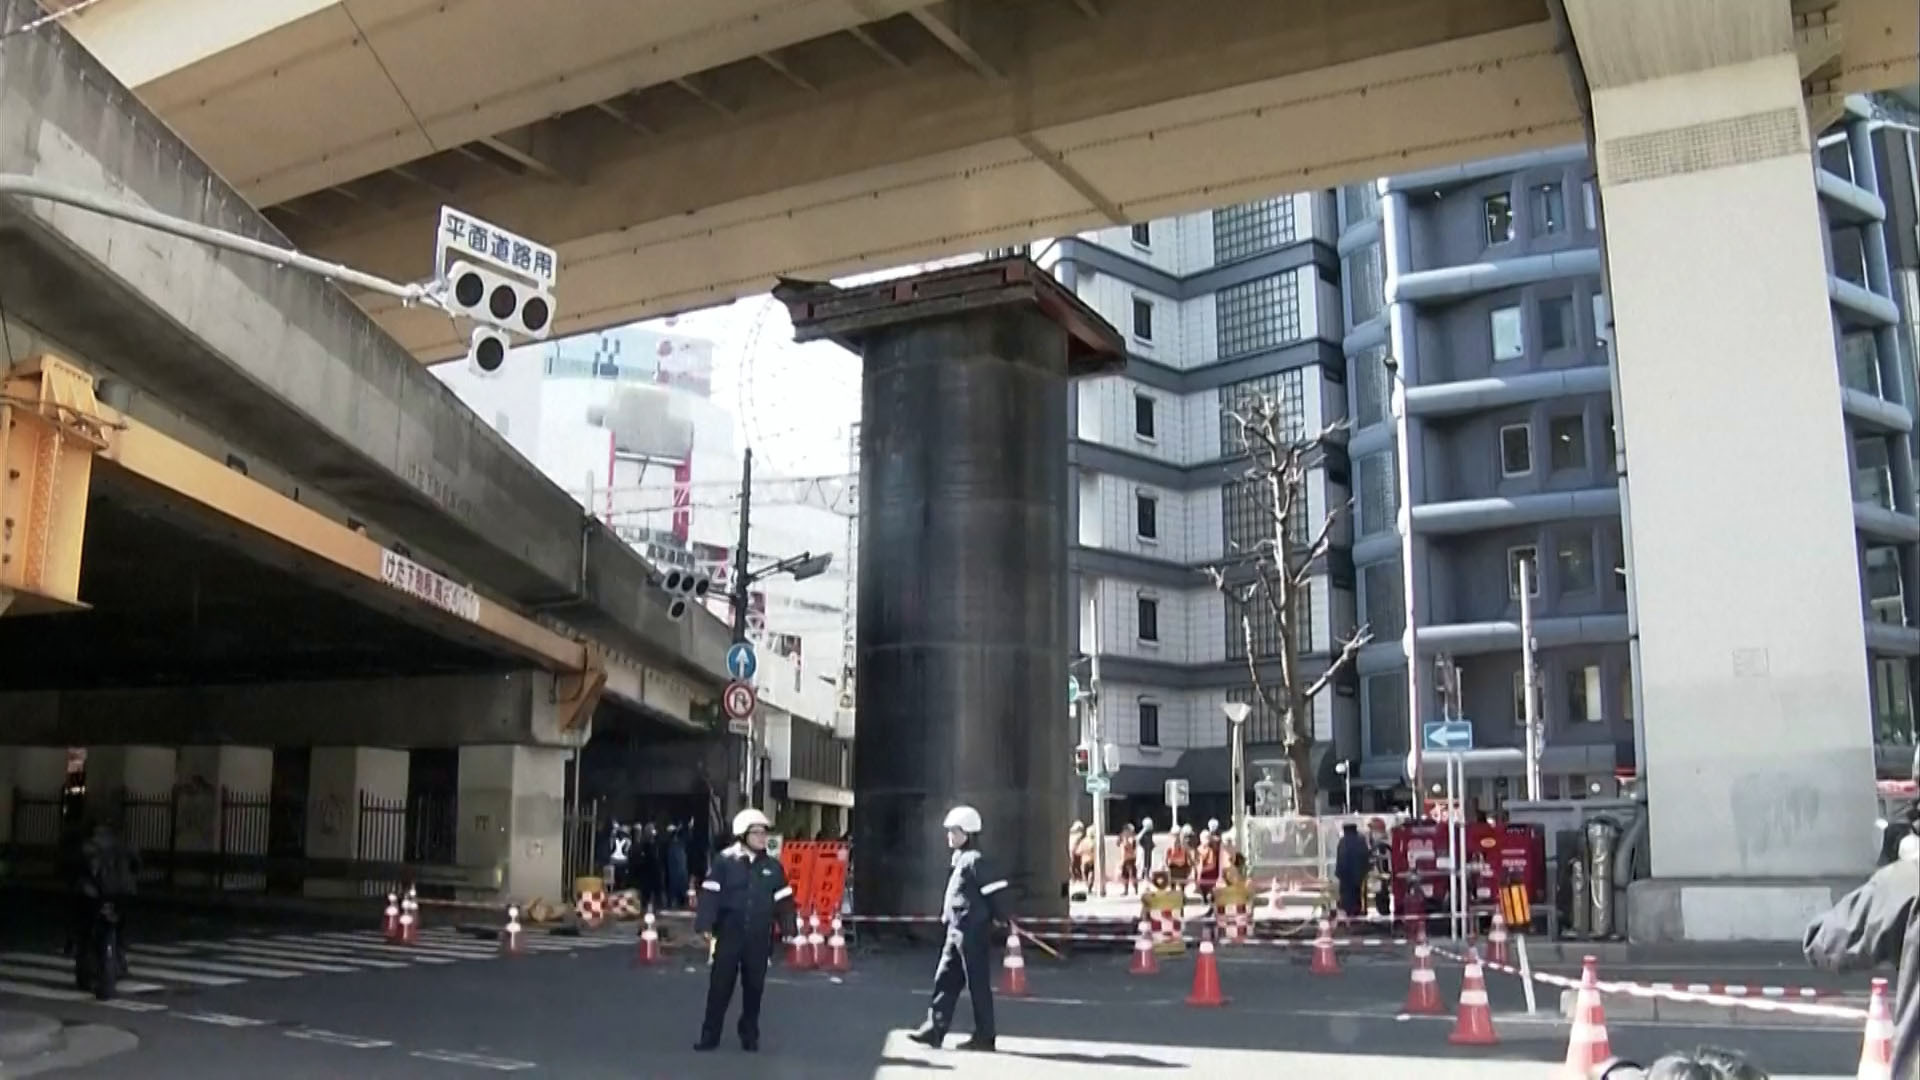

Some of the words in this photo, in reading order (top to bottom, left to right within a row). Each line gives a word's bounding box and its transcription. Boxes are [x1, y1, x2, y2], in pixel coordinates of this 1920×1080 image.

[446, 213, 552, 279] 平面道路用
